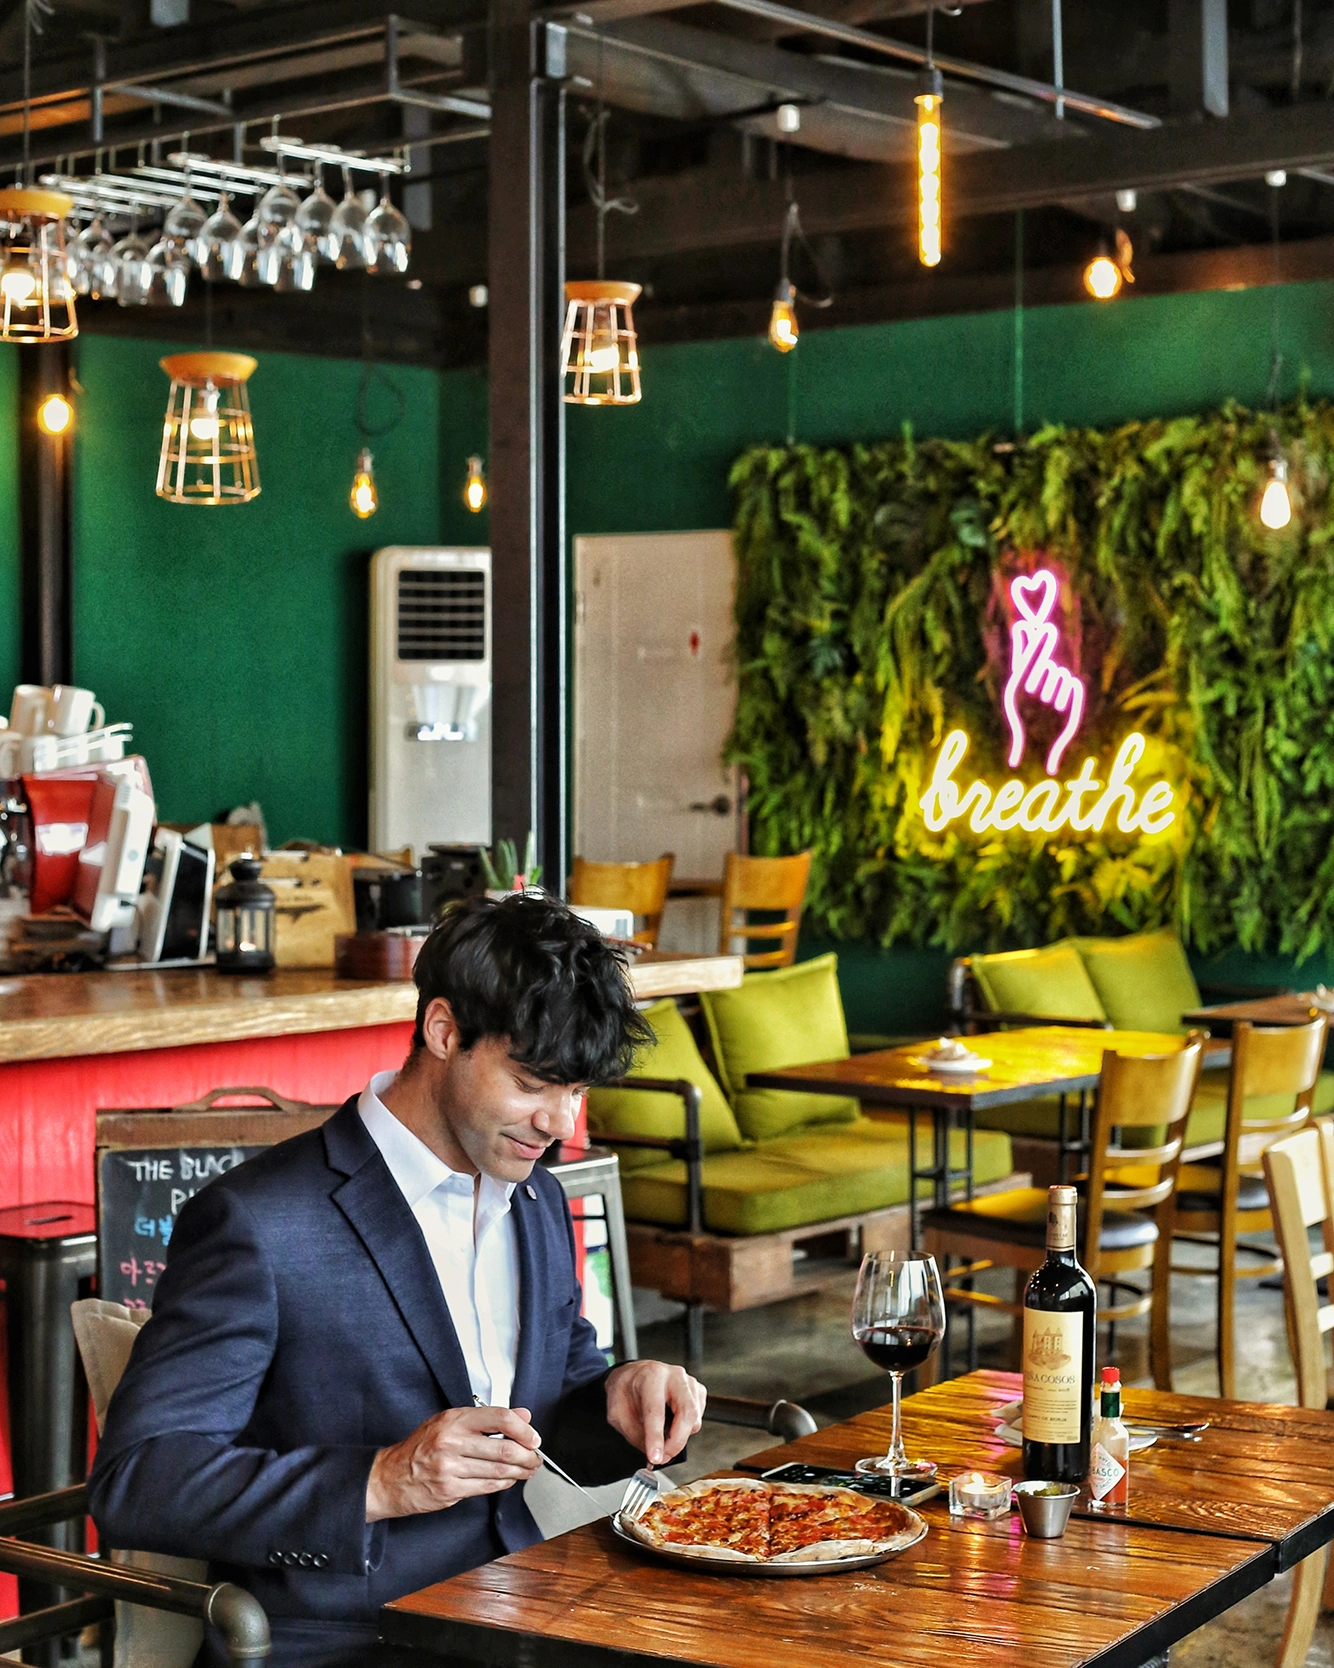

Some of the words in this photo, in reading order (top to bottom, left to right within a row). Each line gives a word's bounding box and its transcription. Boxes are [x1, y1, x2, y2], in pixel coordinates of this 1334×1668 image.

[919, 729, 1175, 834] breathe
[127, 1158, 174, 1182] THE
[1040, 1374, 1076, 1384] COSOS
